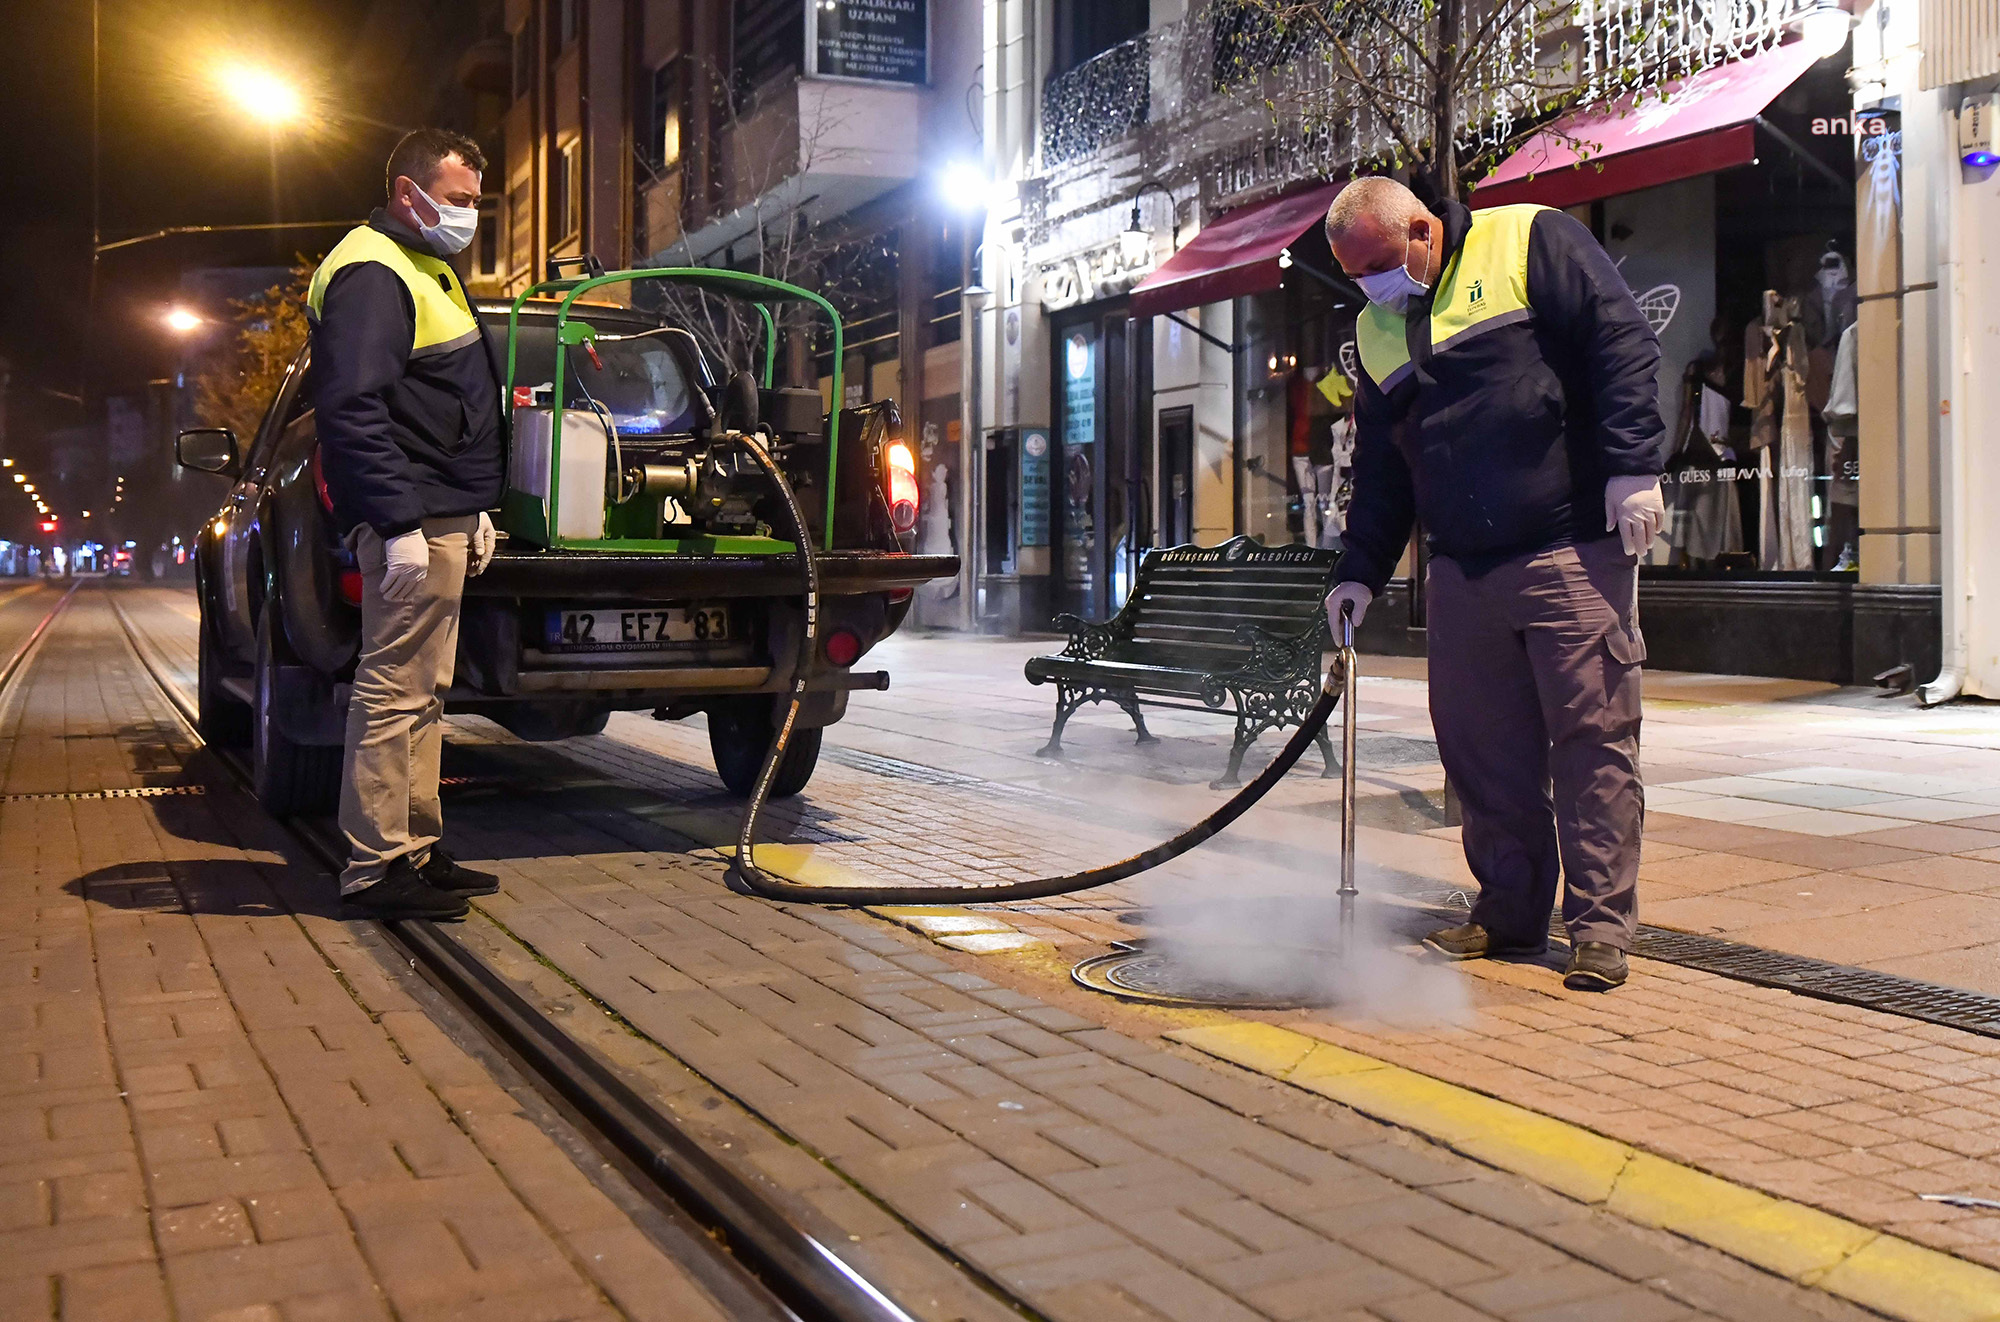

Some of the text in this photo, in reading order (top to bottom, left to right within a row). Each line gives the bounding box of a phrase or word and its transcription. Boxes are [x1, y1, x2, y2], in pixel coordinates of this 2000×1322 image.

[848, 10, 897, 24] UZMANI
[1679, 469, 1711, 484] GUESS
[1161, 551, 1221, 563] BÜYÜKŞEHİR
[1246, 551, 1315, 562] BELEDİYESİ
[563, 613, 596, 643] 42
[621, 612, 671, 642] EFZ
[694, 610, 727, 640] 83
